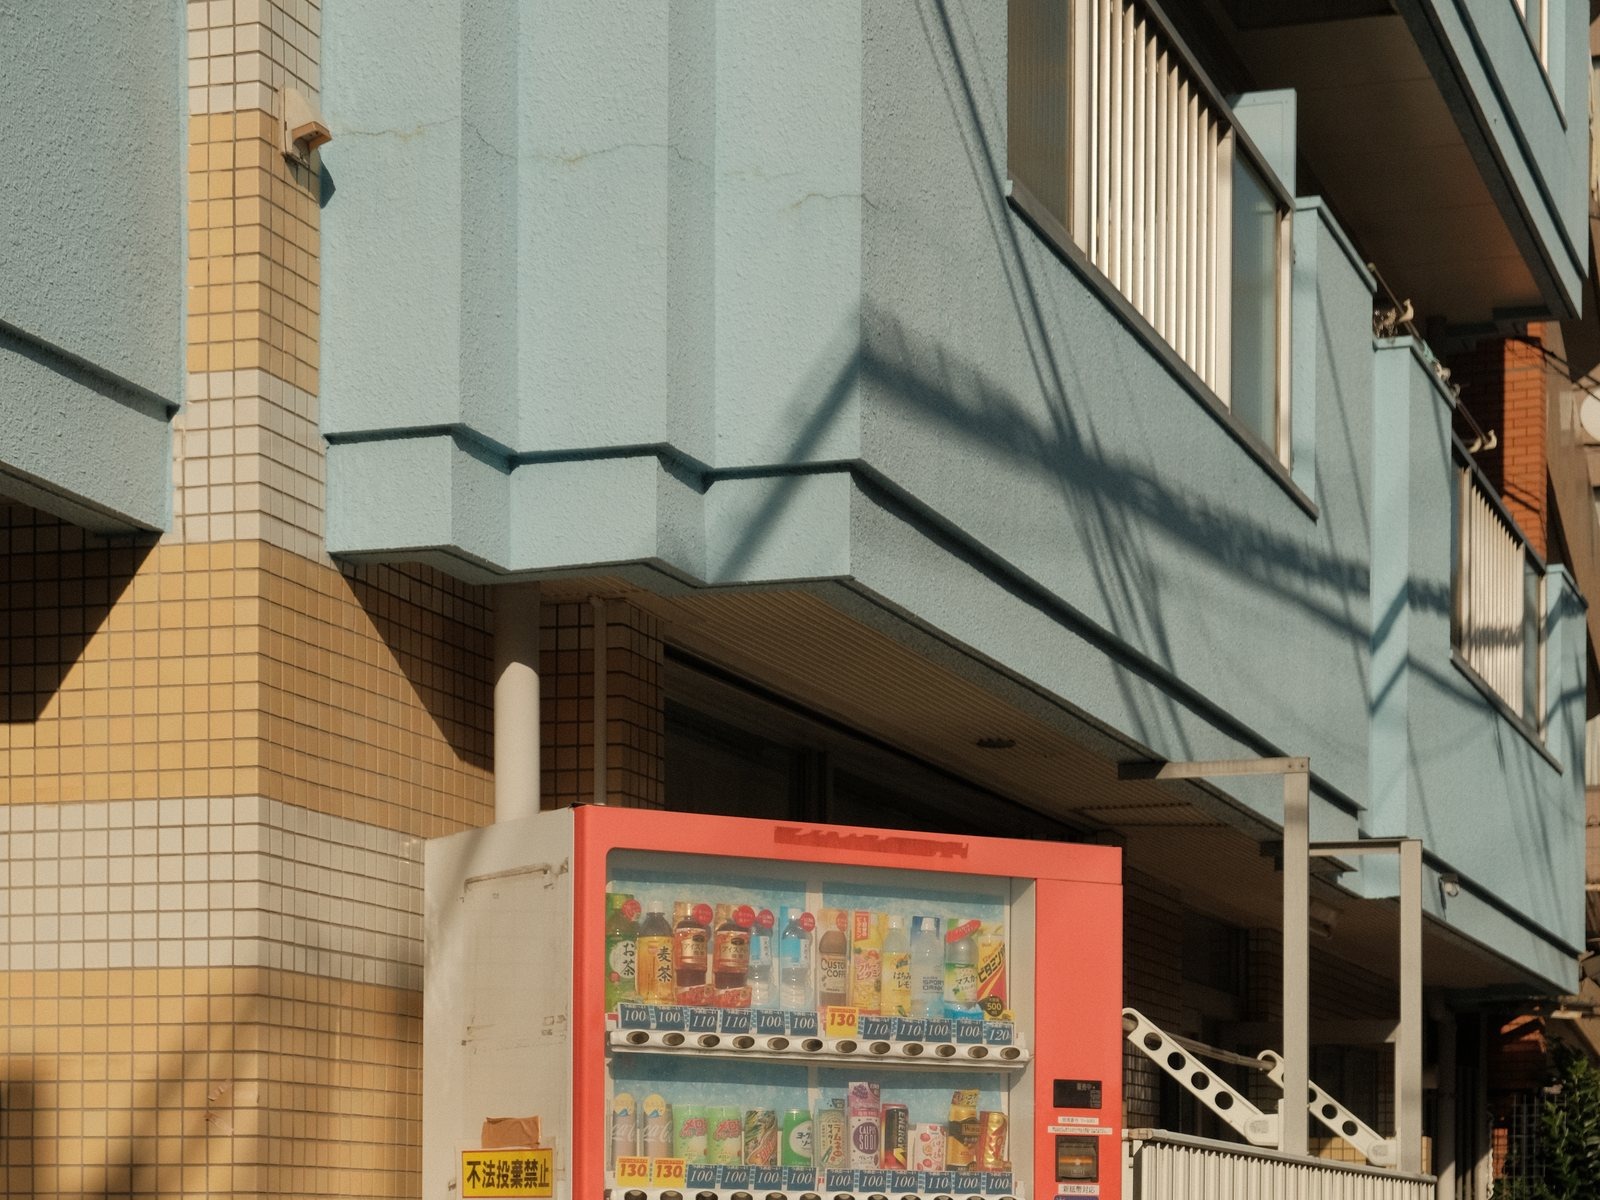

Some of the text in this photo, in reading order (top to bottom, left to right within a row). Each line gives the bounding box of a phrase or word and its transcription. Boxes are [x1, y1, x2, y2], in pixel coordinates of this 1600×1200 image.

[657, 946, 673, 982] 麦茶
[820, 959, 846, 970] CUSTO
[893, 972, 911, 980] はちみ
[897, 981, 911, 989] レモ
[987, 1002, 1002, 1011] 500
[625, 1010, 646, 1022] 100
[660, 1012, 681, 1023] 100
[693, 1015, 715, 1027] 110
[725, 1016, 747, 1028] 110
[761, 1016, 782, 1027] 100
[830, 1013, 856, 1026] 130
[793, 1017, 815, 1029] 100
[866, 1023, 889, 1035] 110
[900, 1024, 922, 1036] 110
[928, 1024, 949, 1036] 100
[960, 1025, 980, 1037] 100
[990, 1029, 1010, 1041] 120
[898, 1111, 906, 1150] ENERGY
[466, 1158, 550, 1189] 不法投棄禁止
[620, 1164, 647, 1177] 130
[656, 1165, 683, 1178] 130
[691, 1170, 713, 1182] 100
[725, 1171, 747, 1183] 100
[758, 1171, 779, 1183] 100
[791, 1172, 813, 1184] 100
[829, 1175, 851, 1187] 100
[862, 1175, 884, 1187] 100
[895, 1176, 915, 1187] 100
[928, 1177, 949, 1189] 110
[958, 1177, 978, 1189] 100
[989, 1178, 1010, 1189] 100
